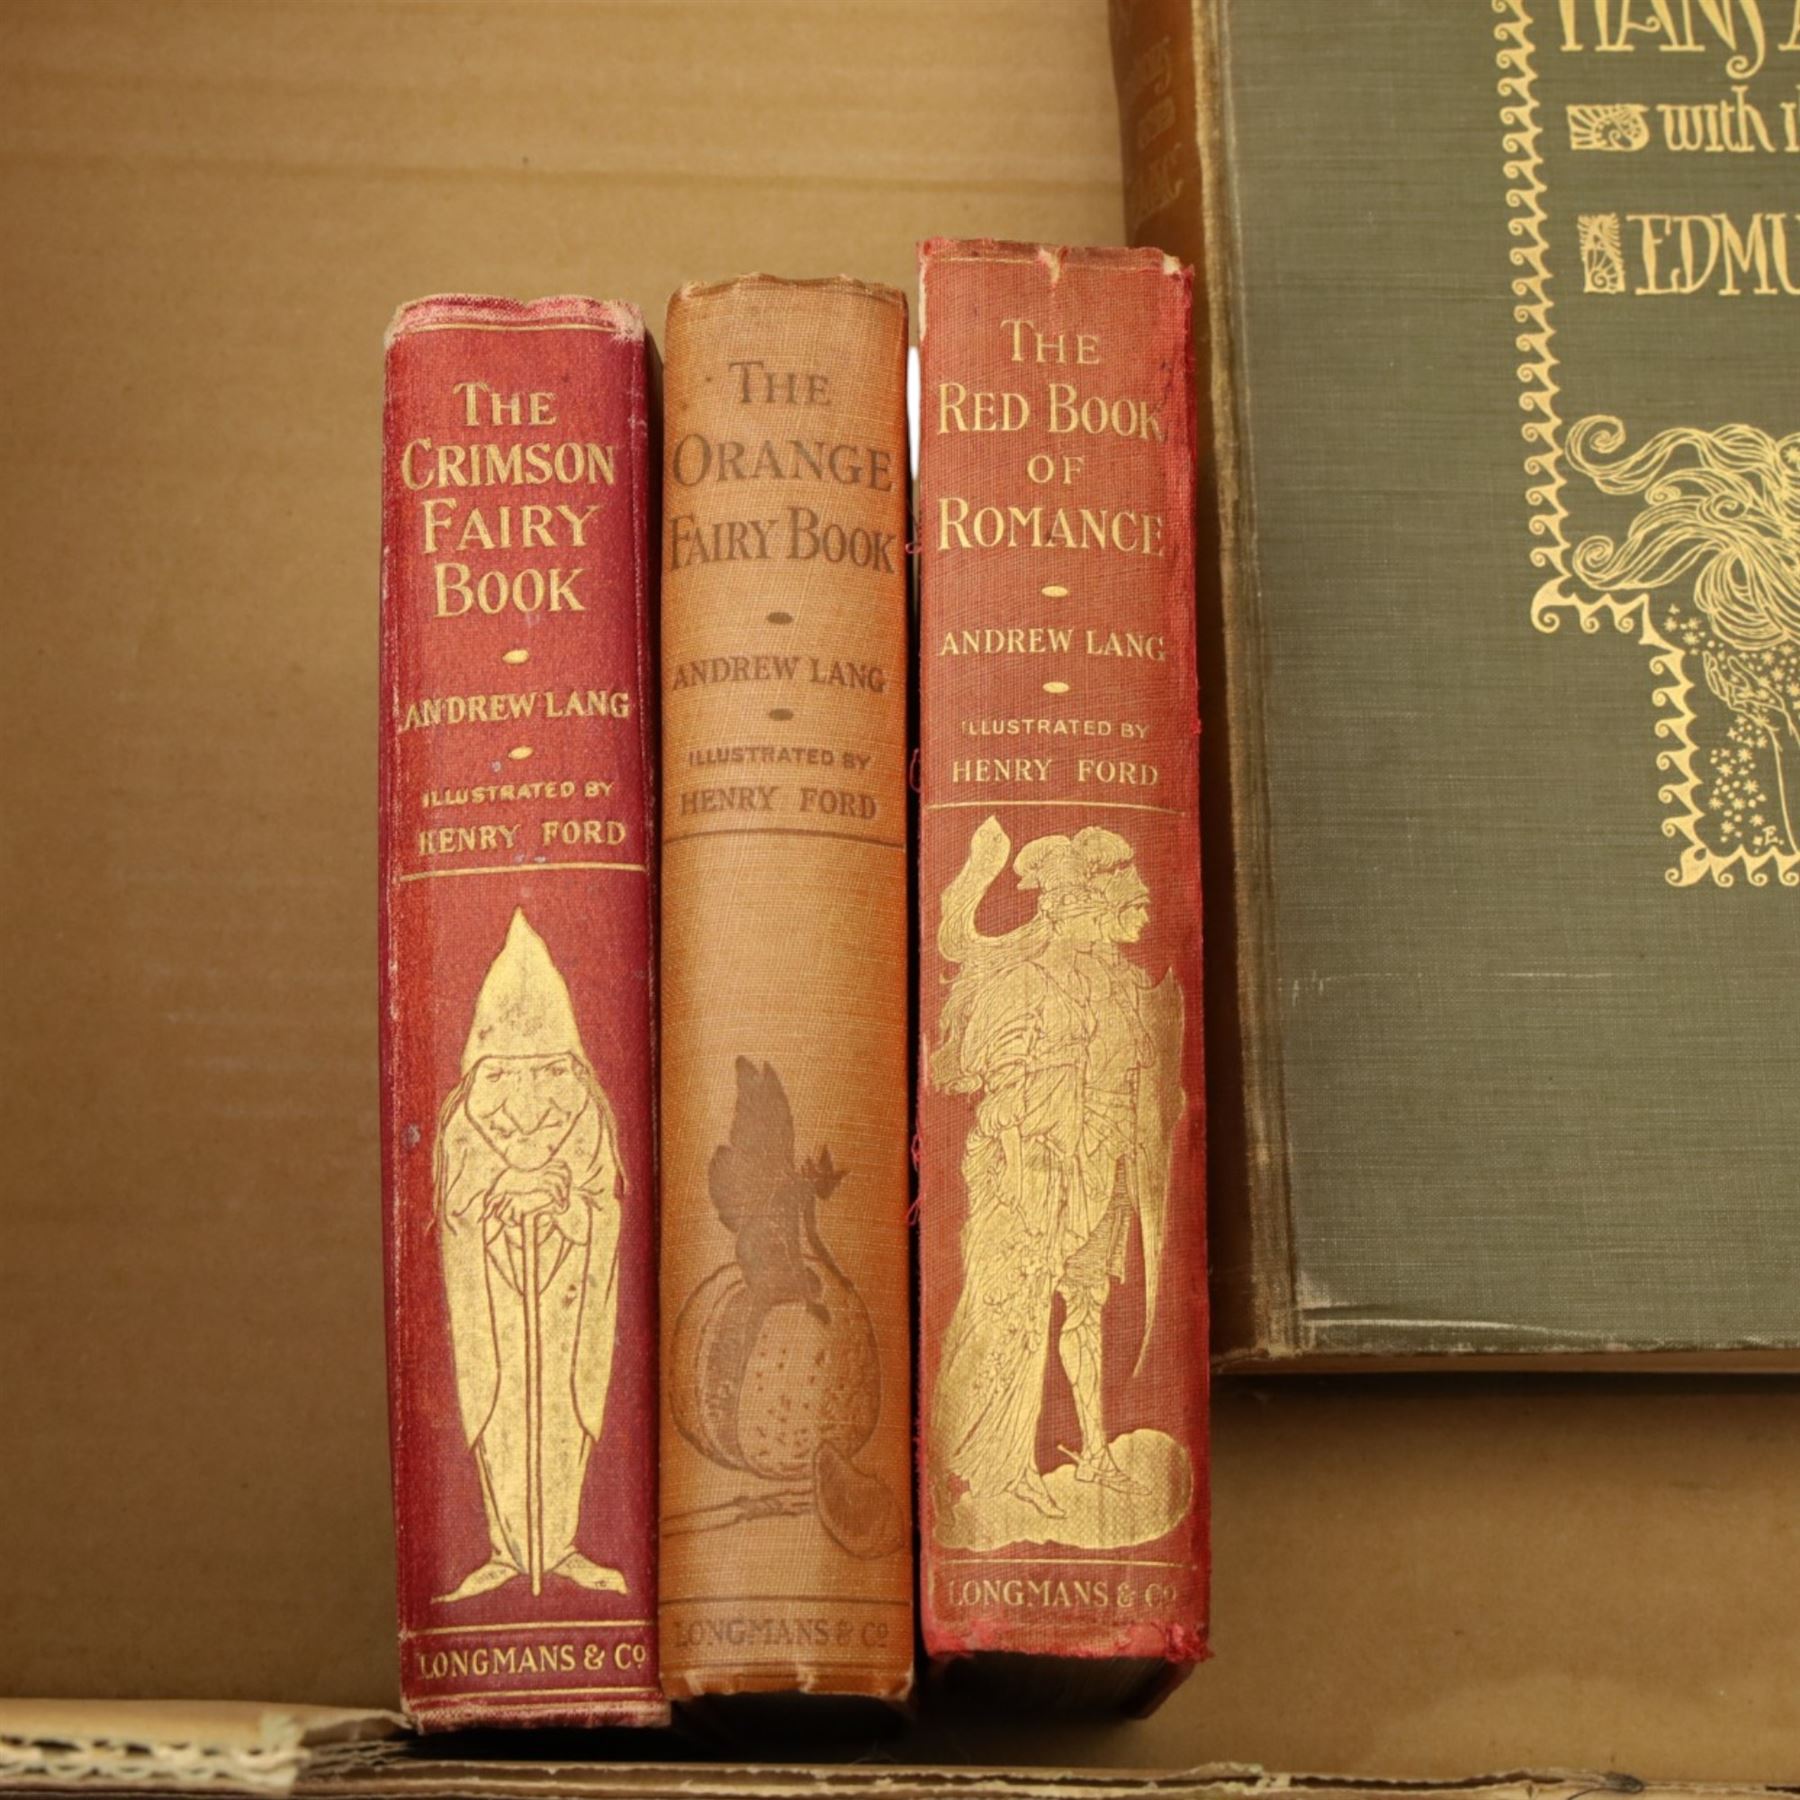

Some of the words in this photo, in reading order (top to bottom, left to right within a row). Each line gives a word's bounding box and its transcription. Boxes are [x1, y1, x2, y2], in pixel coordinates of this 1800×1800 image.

[1656, 85, 1776, 152] with
[1000, 319, 1100, 364] THE
[728, 360, 831, 406] THE
[453, 381, 557, 427] THE
[937, 382, 1031, 435] RED
[1048, 383, 1166, 442] BOOK
[401, 437, 615, 491] CRIMSON
[672, 433, 893, 492] ORANGE
[1026, 454, 1085, 485] OF
[421, 497, 600, 554] FAIRY
[670, 514, 780, 572] FAIRY
[785, 507, 897, 574] BOOK
[937, 497, 1165, 557] ROMANCE
[433, 562, 586, 618] BOOK
[939, 628, 1073, 656] ANDREW
[1085, 630, 1166, 662] LANG
[672, 655, 802, 691] ANDREW
[809, 658, 886, 693] LANG
[399, 692, 537, 733] ANDREW
[543, 690, 630, 719] LANG
[961, 719, 1112, 737] ILLUSTRATED
[1121, 722, 1150, 739] BY
[688, 747, 834, 767] ILLUSTRATED
[842, 752, 872, 770] BY
[952, 758, 1053, 784] HENRY
[1077, 759, 1158, 787] FORD
[421, 781, 576, 808] ILLUSTRATED
[584, 781, 615, 797] BY
[680, 786, 779, 816] HENRY
[800, 788, 877, 820] FORD
[418, 824, 521, 855] HENRY
[541, 820, 626, 847] FORD
[950, 1579, 1108, 1607] LONGMANS
[1116, 1584, 1136, 1607] &
[675, 1619, 830, 1648] LONGMANS
[836, 1620, 854, 1647] &
[418, 1644, 576, 1680] LONGMANS
[583, 1644, 606, 1670] &
